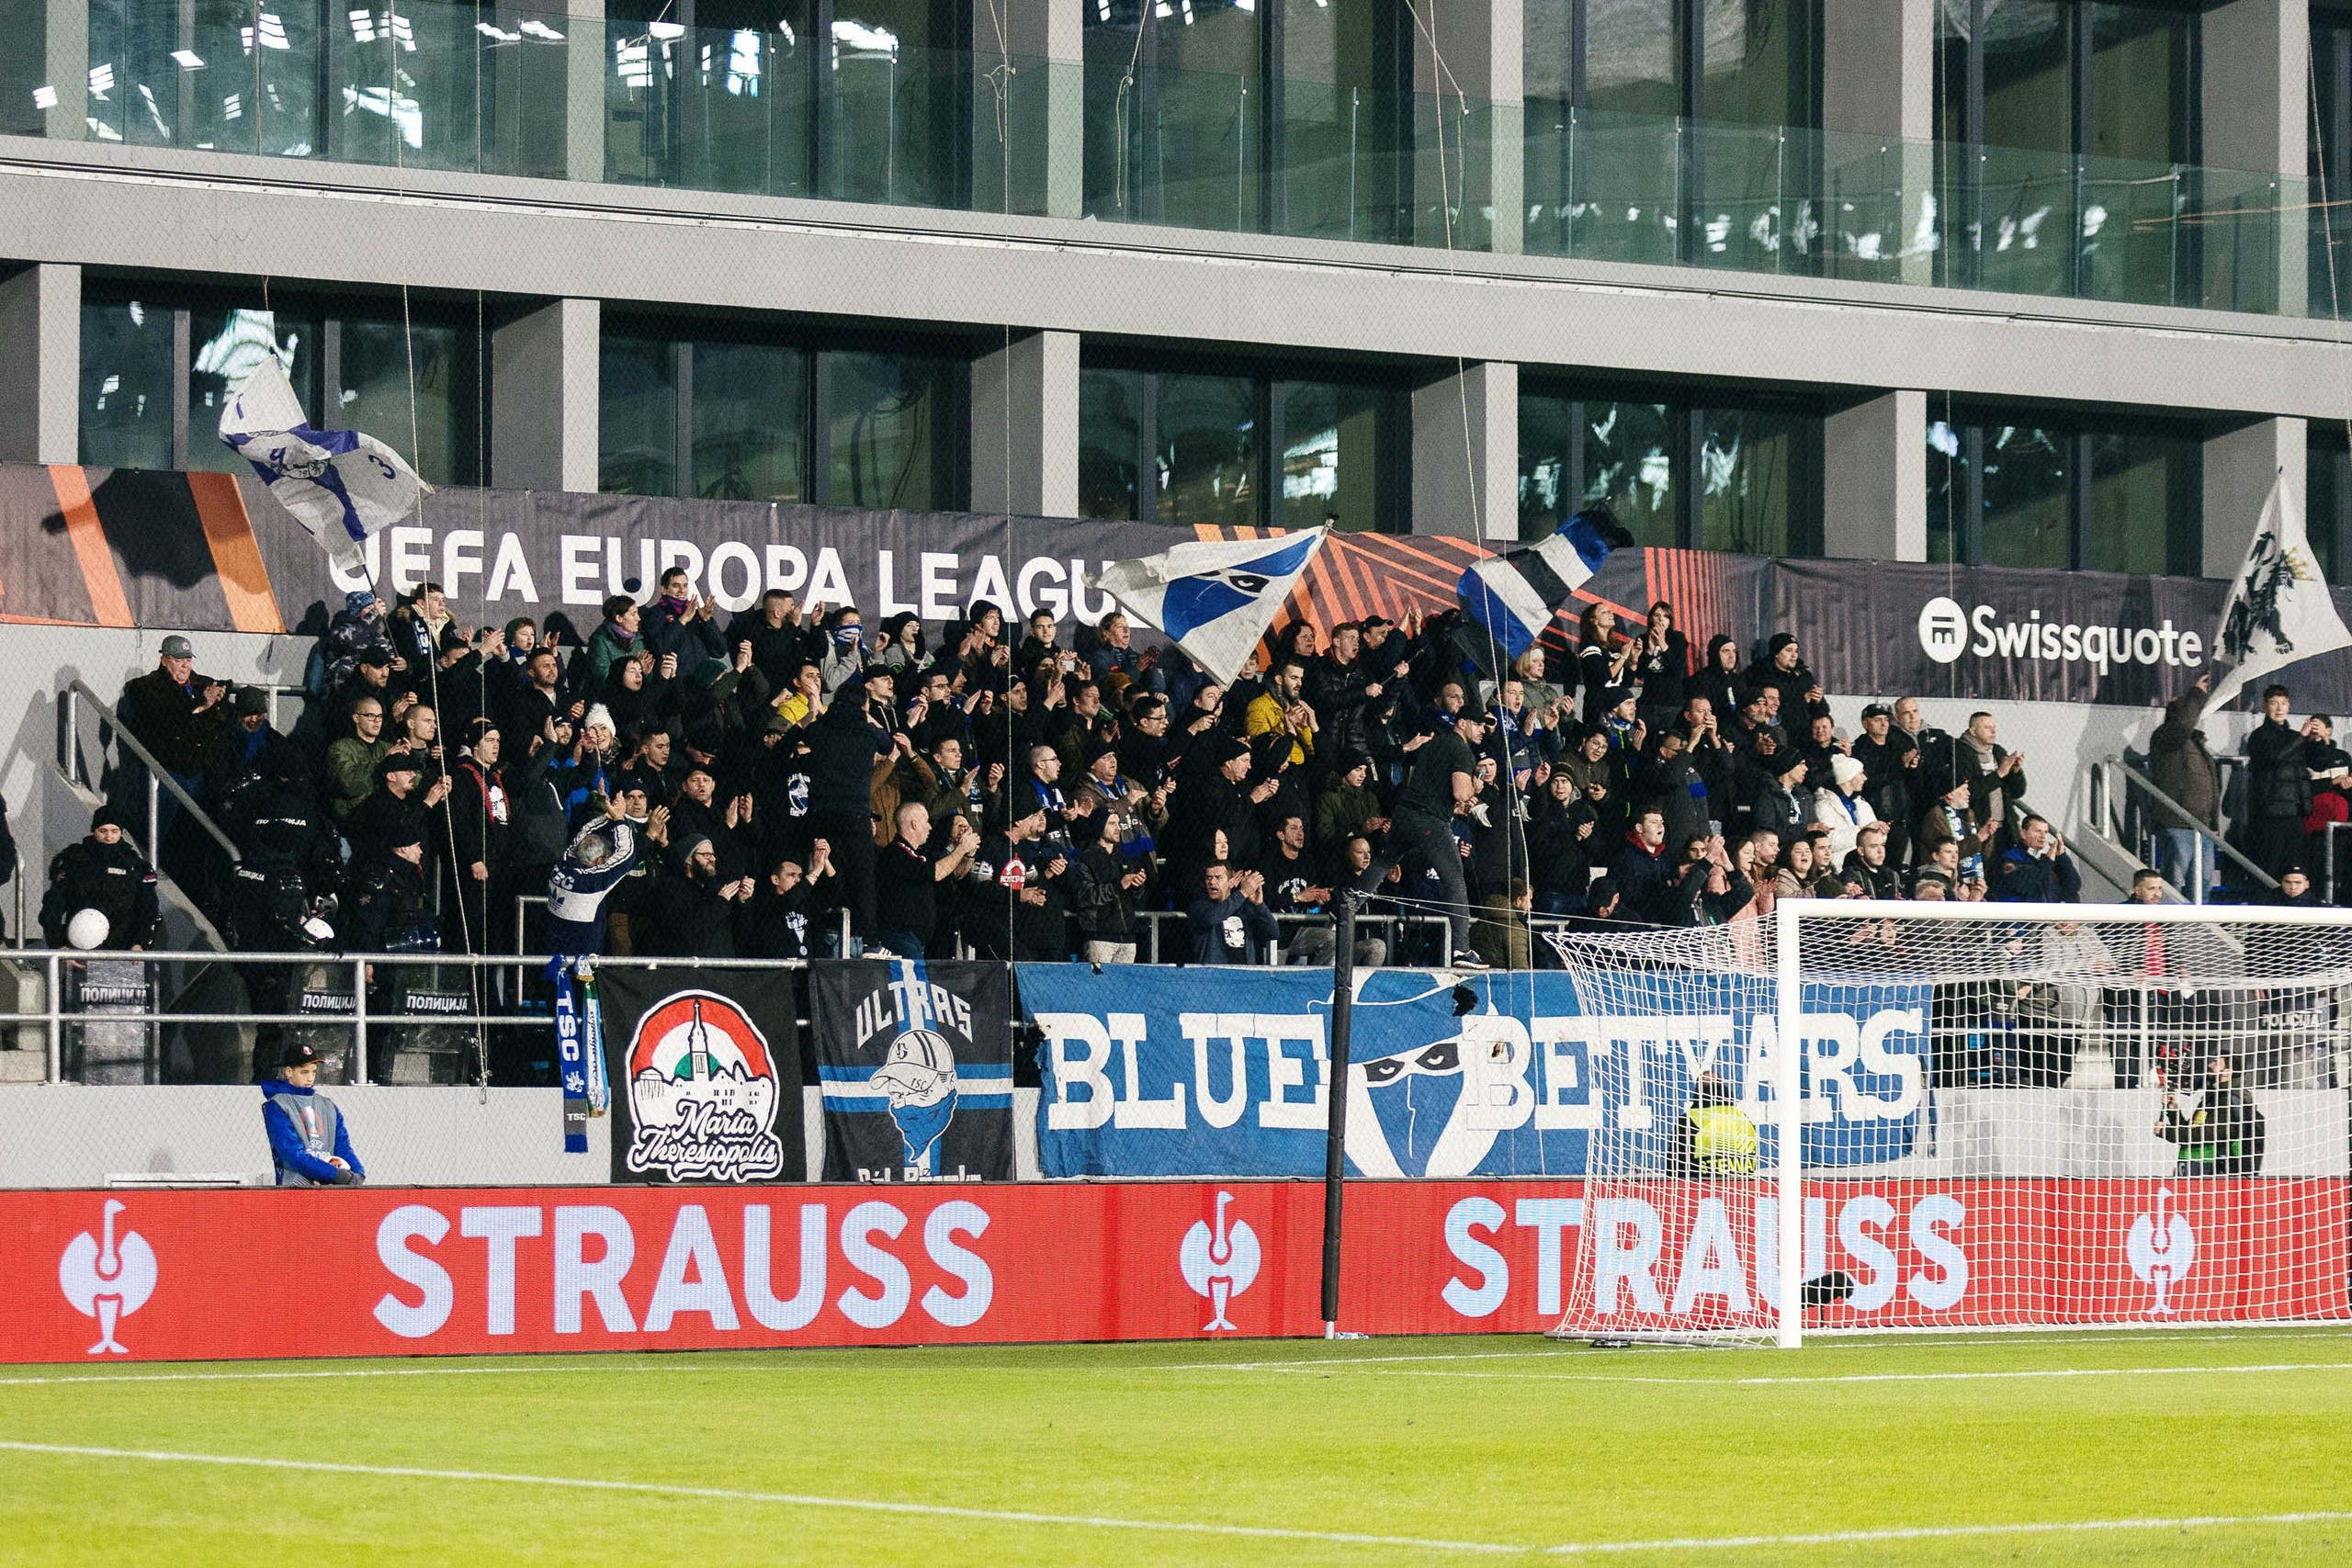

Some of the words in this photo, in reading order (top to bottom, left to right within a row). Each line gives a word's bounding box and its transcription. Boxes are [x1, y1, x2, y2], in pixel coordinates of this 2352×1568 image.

[329, 526, 539, 603] UEFA
[560, 535, 855, 613] EUROPA
[879, 550, 1152, 628] LEAGU
[1972, 604, 2203, 676] Swissquote
[407, 995, 468, 1012] ПОЛИЦИЈА
[557, 990, 581, 1062] TSC
[855, 980, 973, 1050] ULTRAS
[1046, 1013, 1329, 1130] BLUE
[567, 1112, 587, 1122] TSC
[672, 1100, 756, 1144] Maria
[373, 1200, 993, 1337] STRAUSS
[1441, 1194, 1969, 1317] STRAUSS
